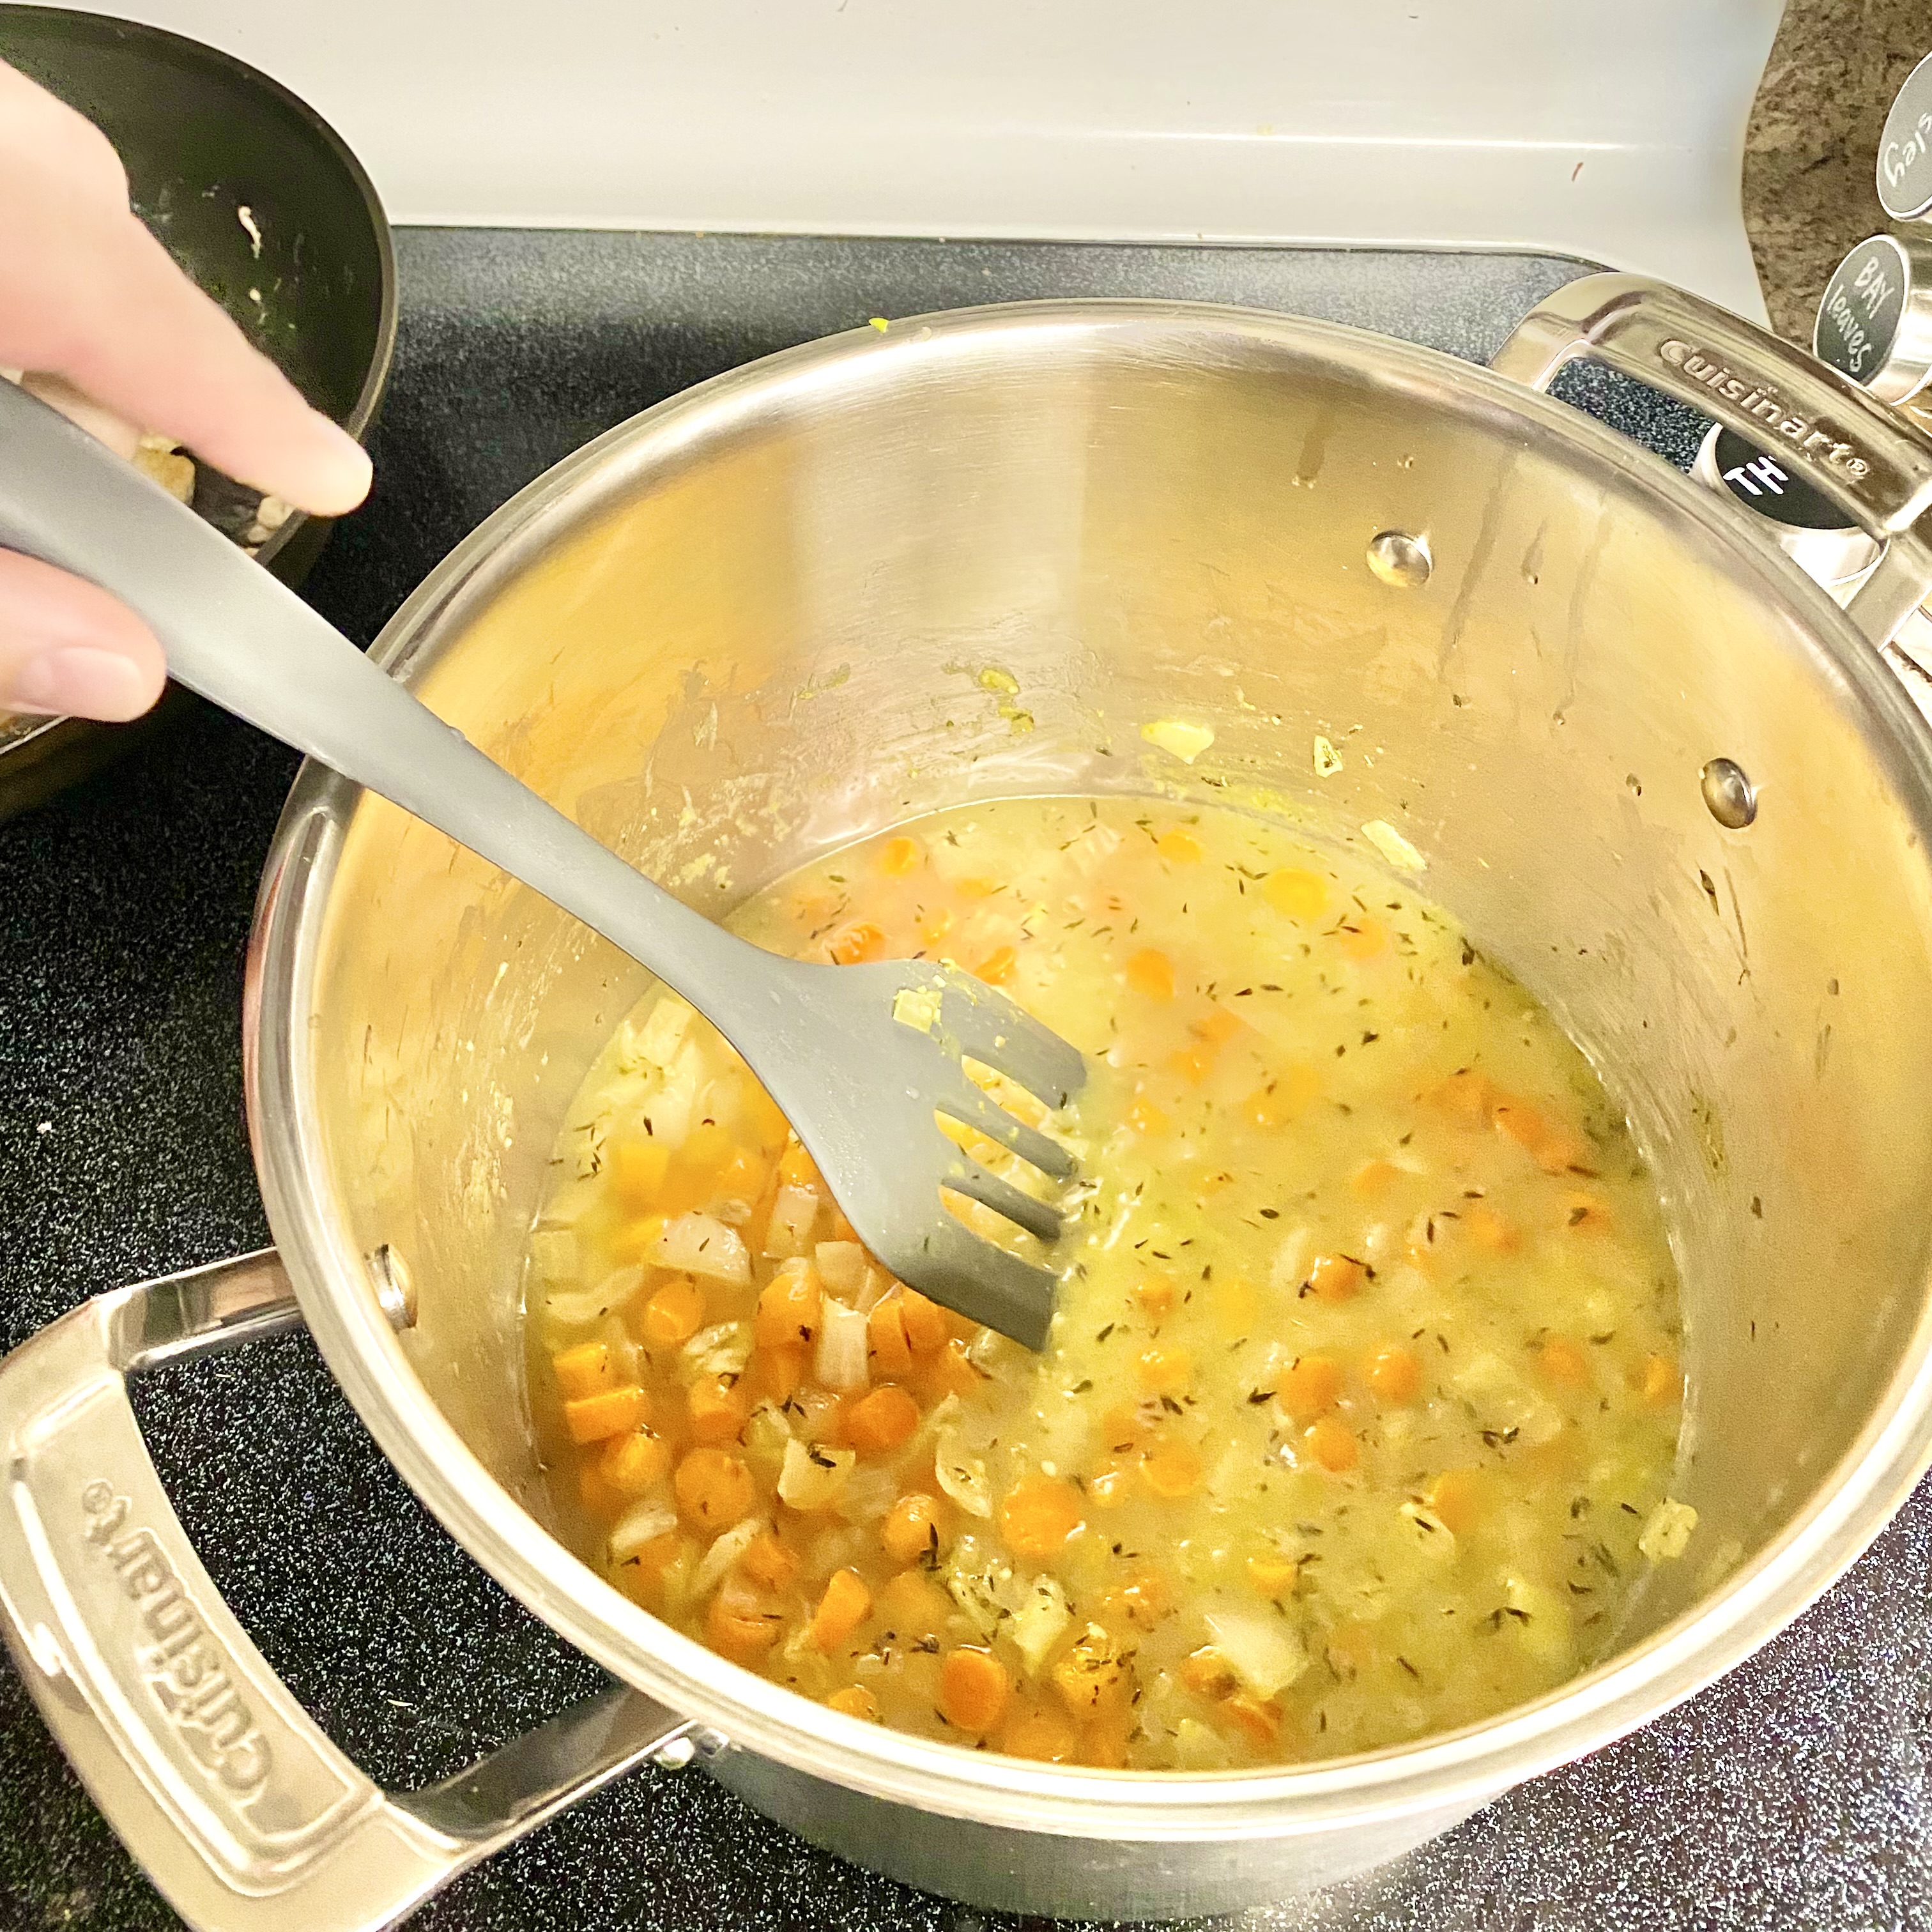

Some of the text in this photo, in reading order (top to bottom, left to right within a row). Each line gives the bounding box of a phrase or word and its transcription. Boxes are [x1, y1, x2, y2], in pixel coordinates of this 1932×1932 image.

[1884, 112, 1932, 187] sley
[1855, 257, 1895, 319] BAY
[1827, 284, 1872, 372] leaves
[1722, 456, 1789, 495] TH
